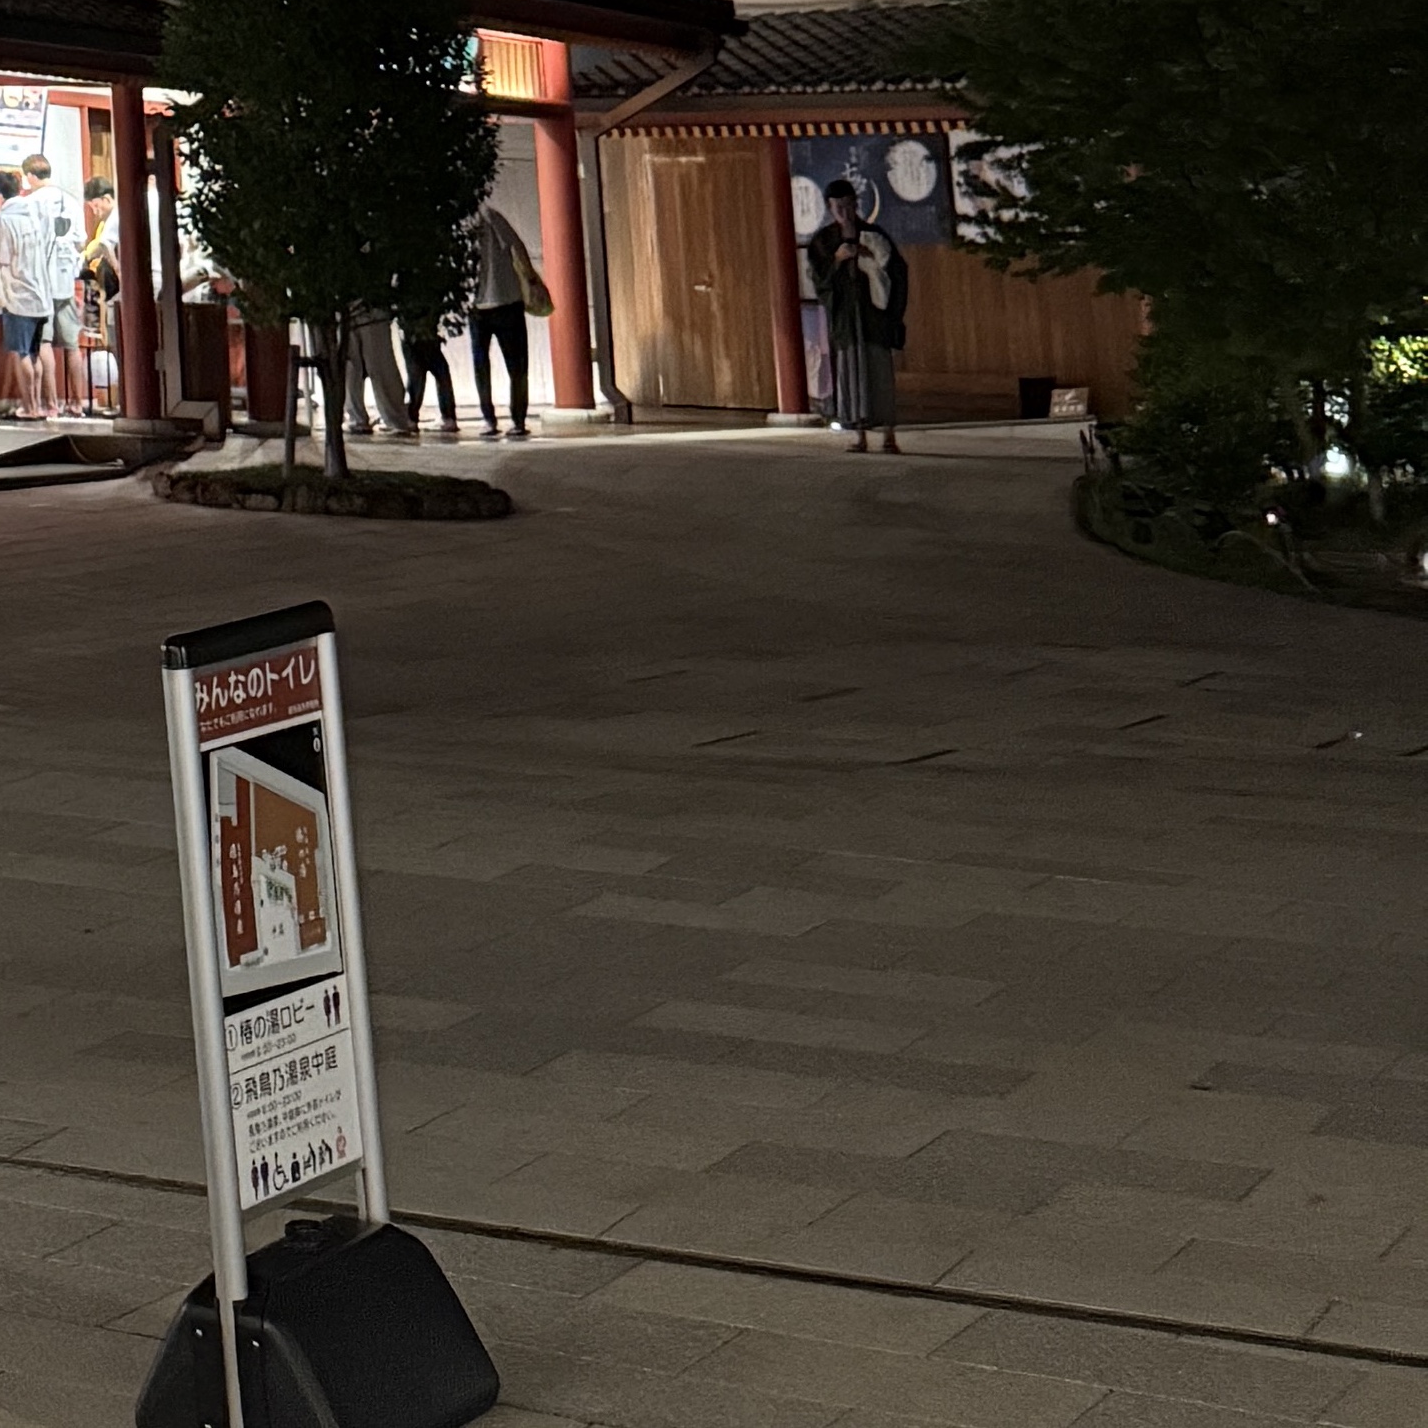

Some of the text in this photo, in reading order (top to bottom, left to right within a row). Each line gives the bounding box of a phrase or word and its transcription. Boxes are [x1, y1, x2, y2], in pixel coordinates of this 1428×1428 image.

[195, 654, 316, 714] みんなのトイレ
